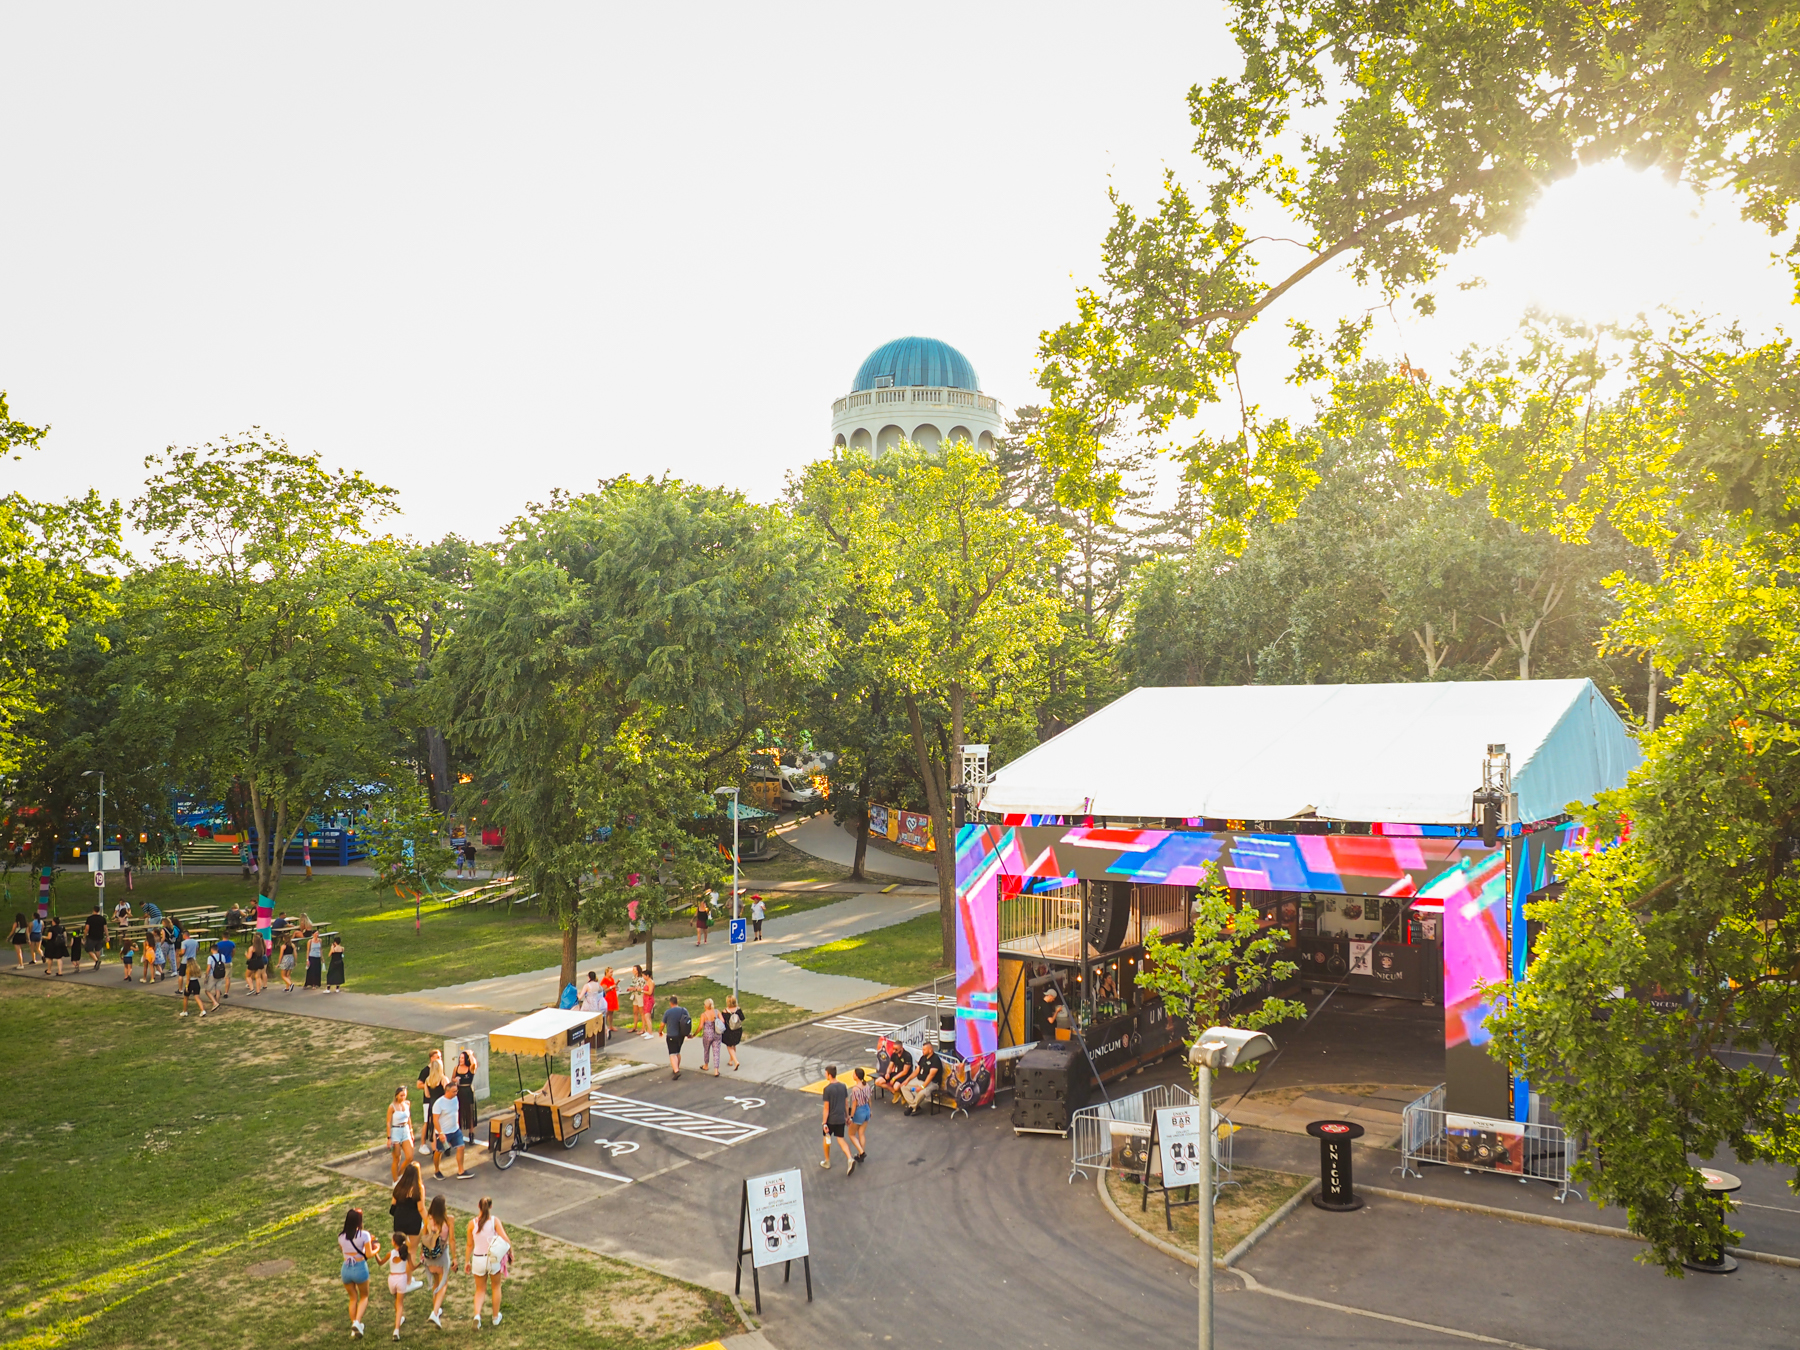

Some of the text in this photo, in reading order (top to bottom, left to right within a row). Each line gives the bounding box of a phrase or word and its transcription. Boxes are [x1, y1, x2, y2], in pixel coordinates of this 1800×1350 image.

[96, 874, 103, 884] 19
[732, 922, 738, 934] P
[1089, 1039, 1121, 1060] UNICUM
[1172, 1116, 1191, 1126] BAR
[1329, 1144, 1341, 1194] UNICUM
[764, 1184, 786, 1195] BAR
